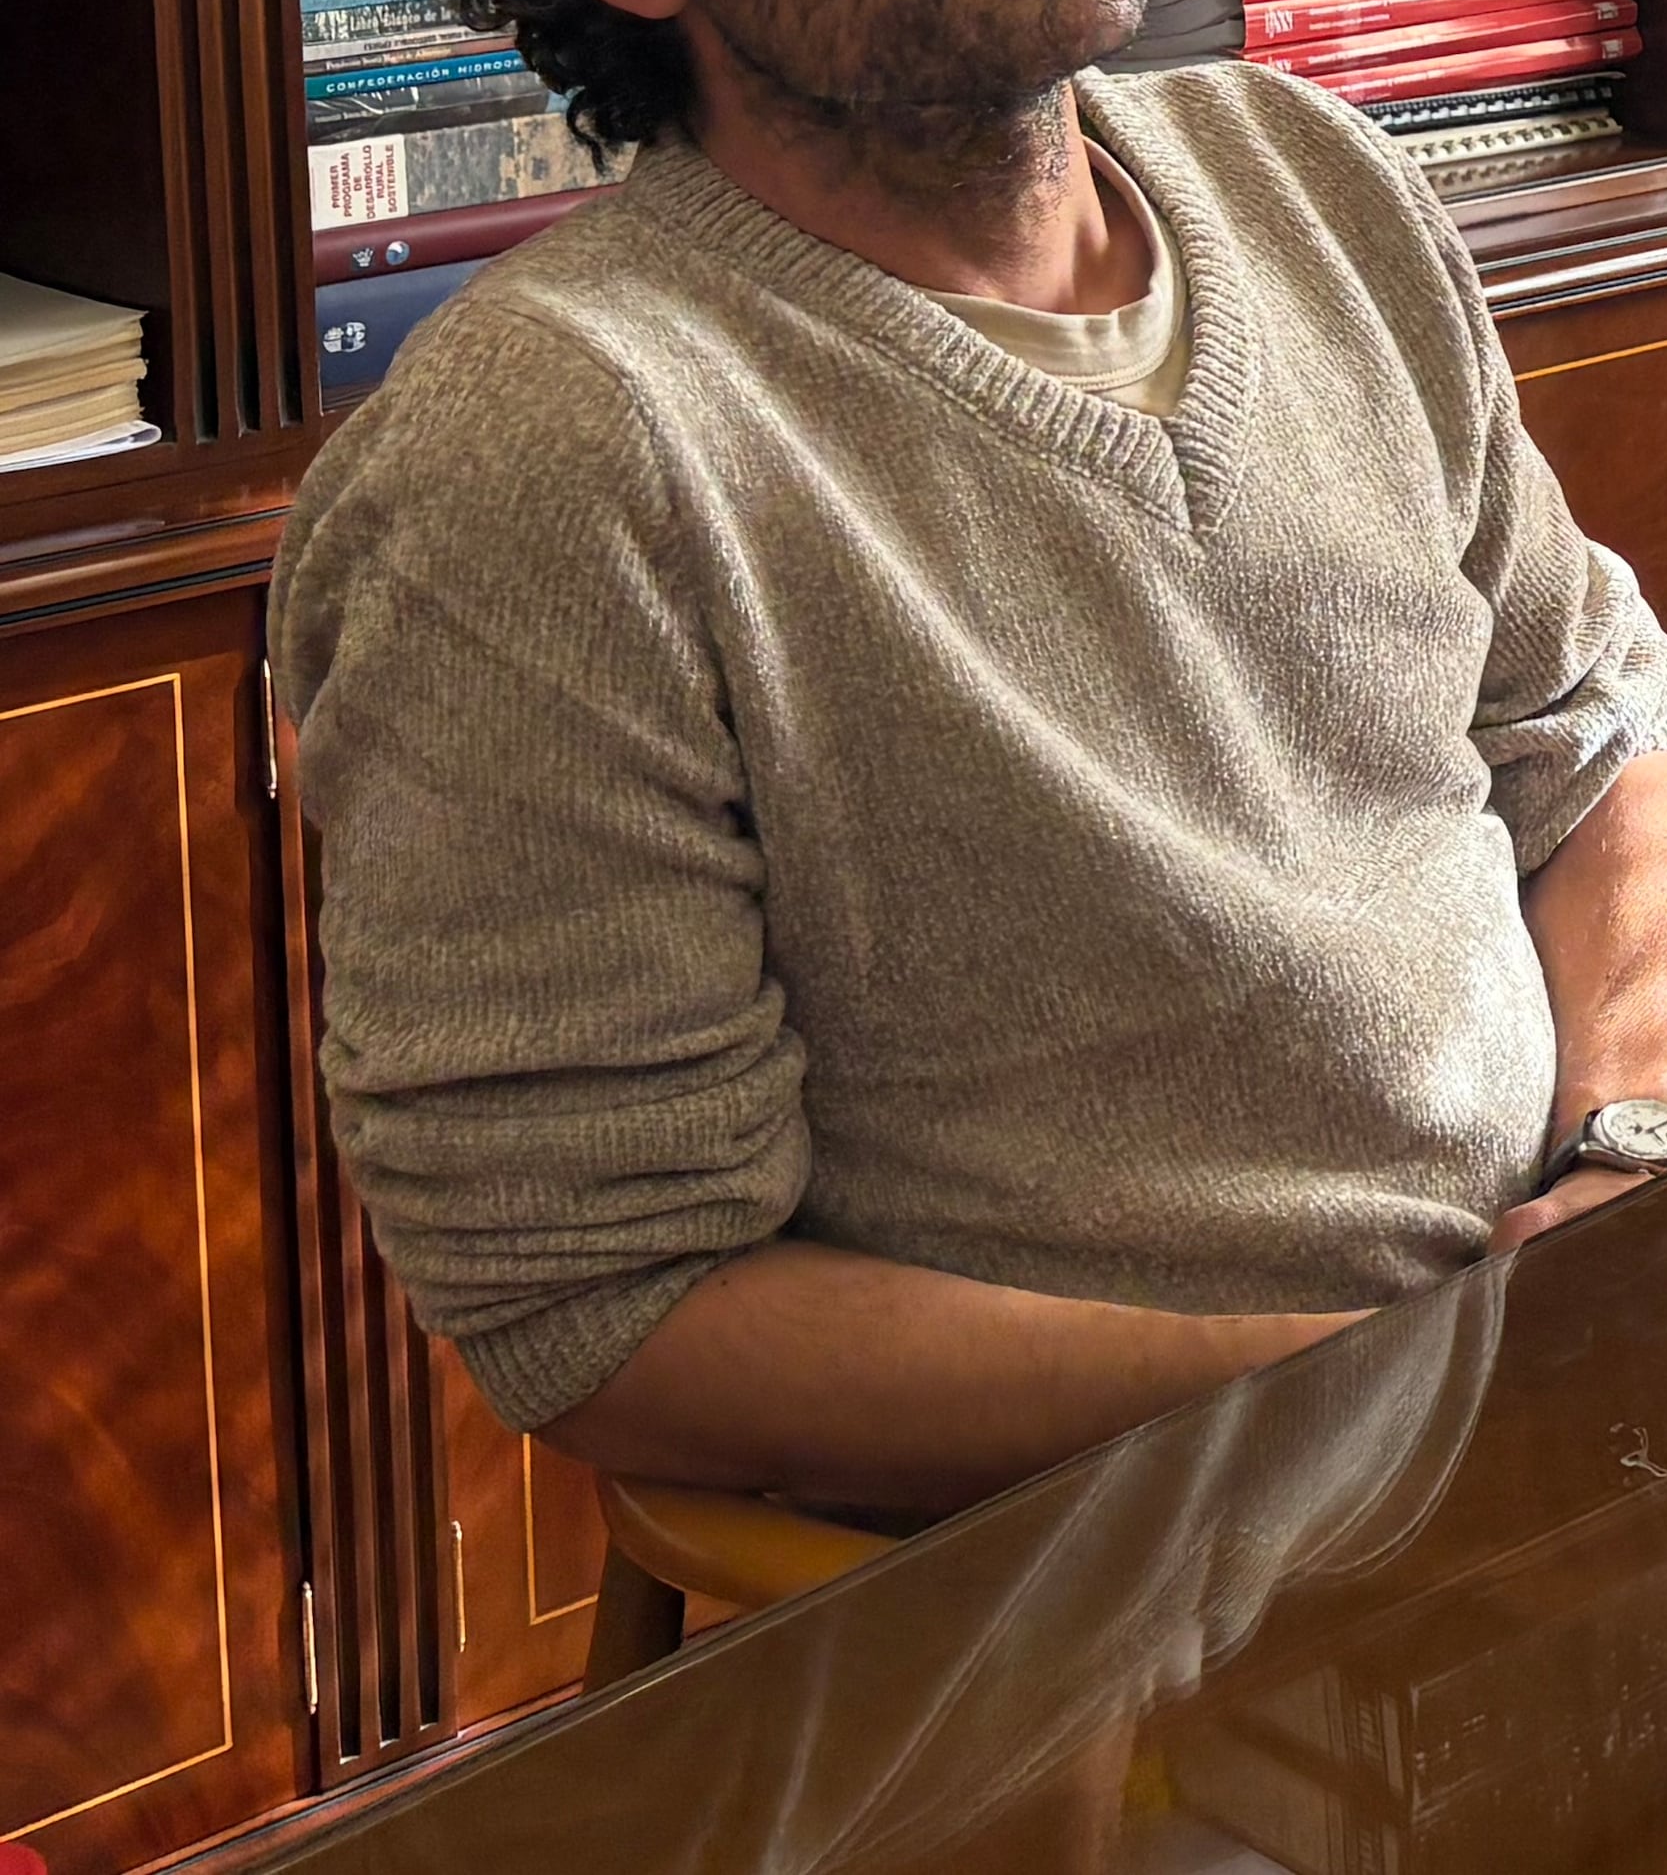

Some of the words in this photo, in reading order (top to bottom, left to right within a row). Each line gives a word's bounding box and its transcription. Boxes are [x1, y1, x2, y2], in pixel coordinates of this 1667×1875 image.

[326, 67, 450, 93] CONFEDERACIÓN
[329, 165, 340, 209] PRIMER
[341, 153, 352, 217] PROGRAMA
[353, 176, 362, 192] DE
[363, 145, 375, 219] DESARROLLO
[375, 161, 384, 199] RURAL
[385, 144, 397, 213] SOSTENIBLE
